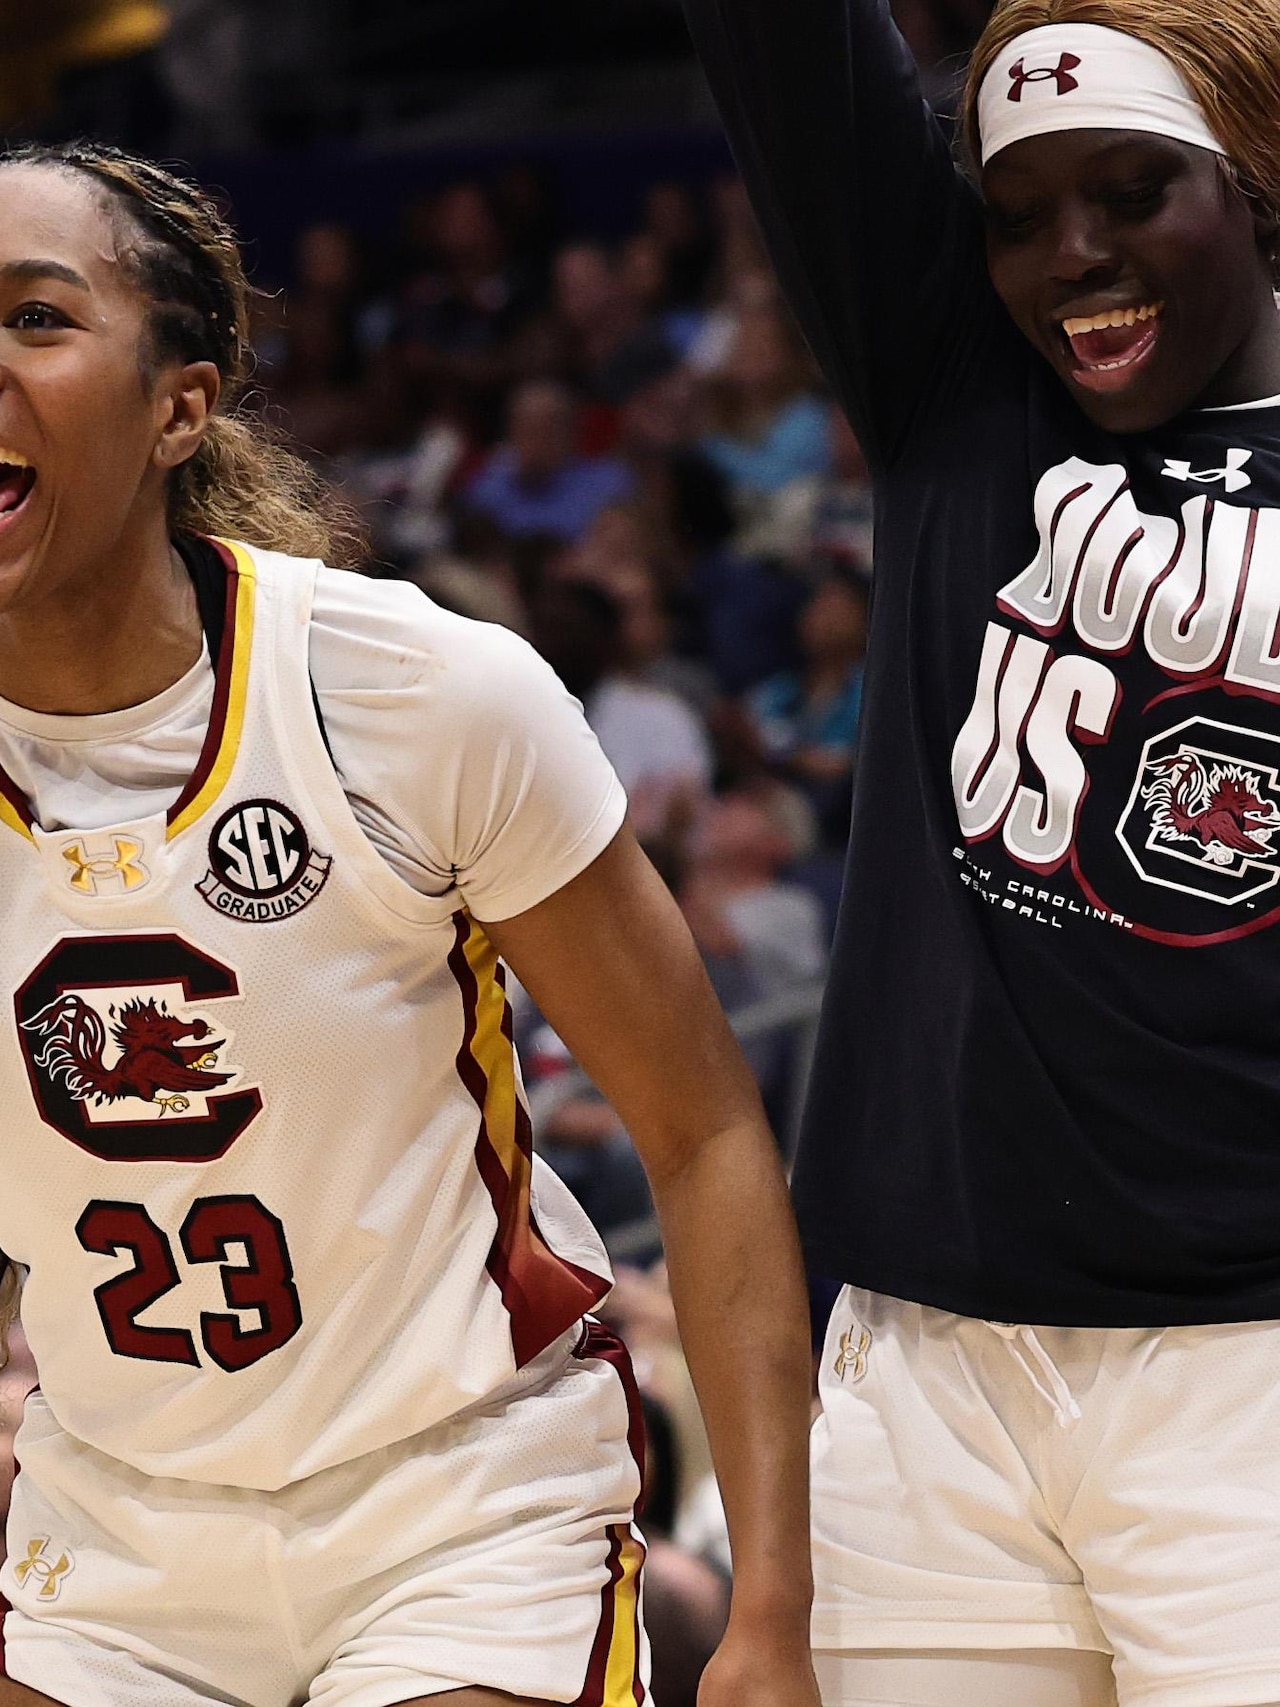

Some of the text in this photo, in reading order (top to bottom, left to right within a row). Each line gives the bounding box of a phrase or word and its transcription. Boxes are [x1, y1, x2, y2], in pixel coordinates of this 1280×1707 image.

[951, 621, 1121, 875] US
[217, 807, 300, 890] SEC
[216, 875, 319, 919] GRADUATE
[1007, 880, 1125, 927] CAROLINA
[75, 1194, 304, 1373] 23
